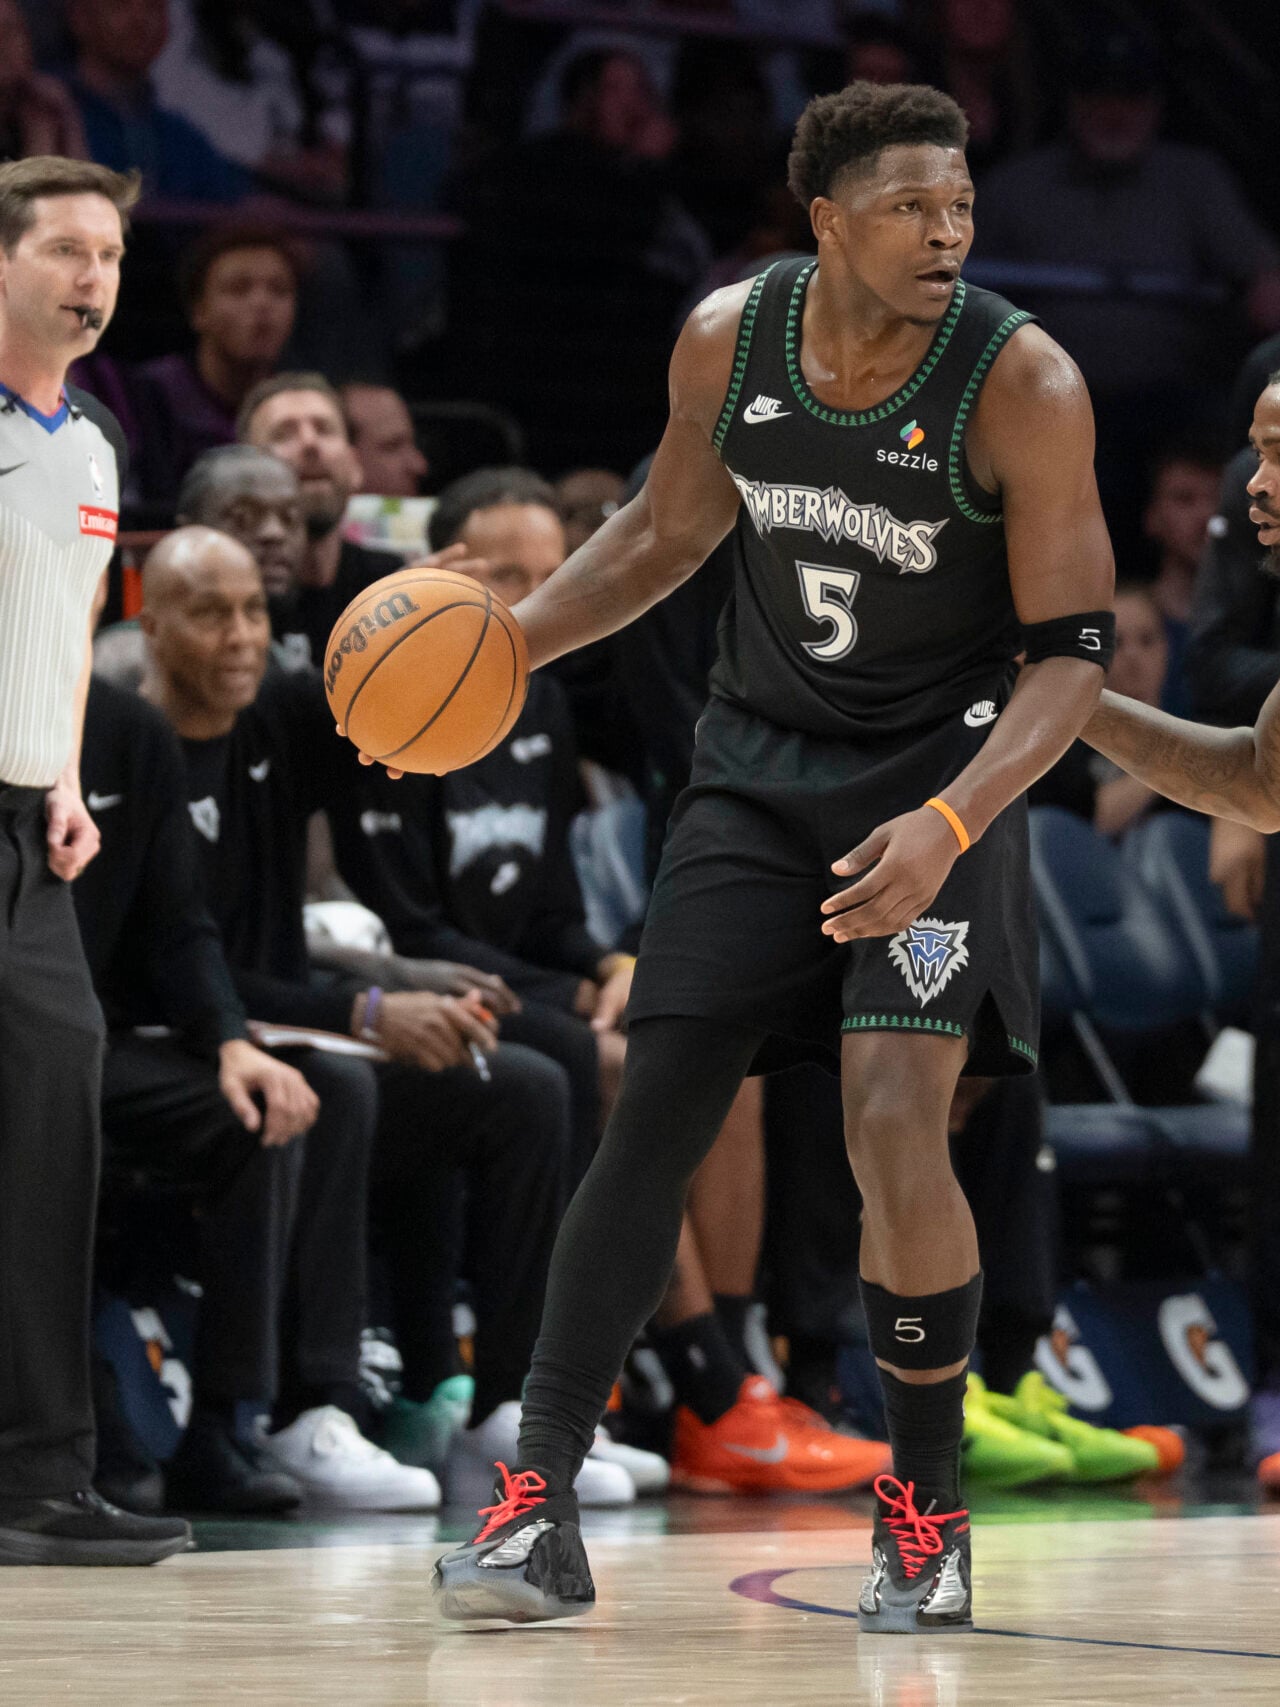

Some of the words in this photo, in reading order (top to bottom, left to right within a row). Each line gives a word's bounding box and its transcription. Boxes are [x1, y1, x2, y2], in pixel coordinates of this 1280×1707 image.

[751, 394, 783, 415] NIKE
[876, 449, 939, 472] sezzle
[732, 473, 950, 575] TIMBERWOLVES
[795, 559, 861, 662] 5
[326, 591, 421, 695] Wilson
[1078, 628, 1101, 651] 5
[970, 699, 997, 718] NIKE
[894, 1317, 926, 1343] 5
